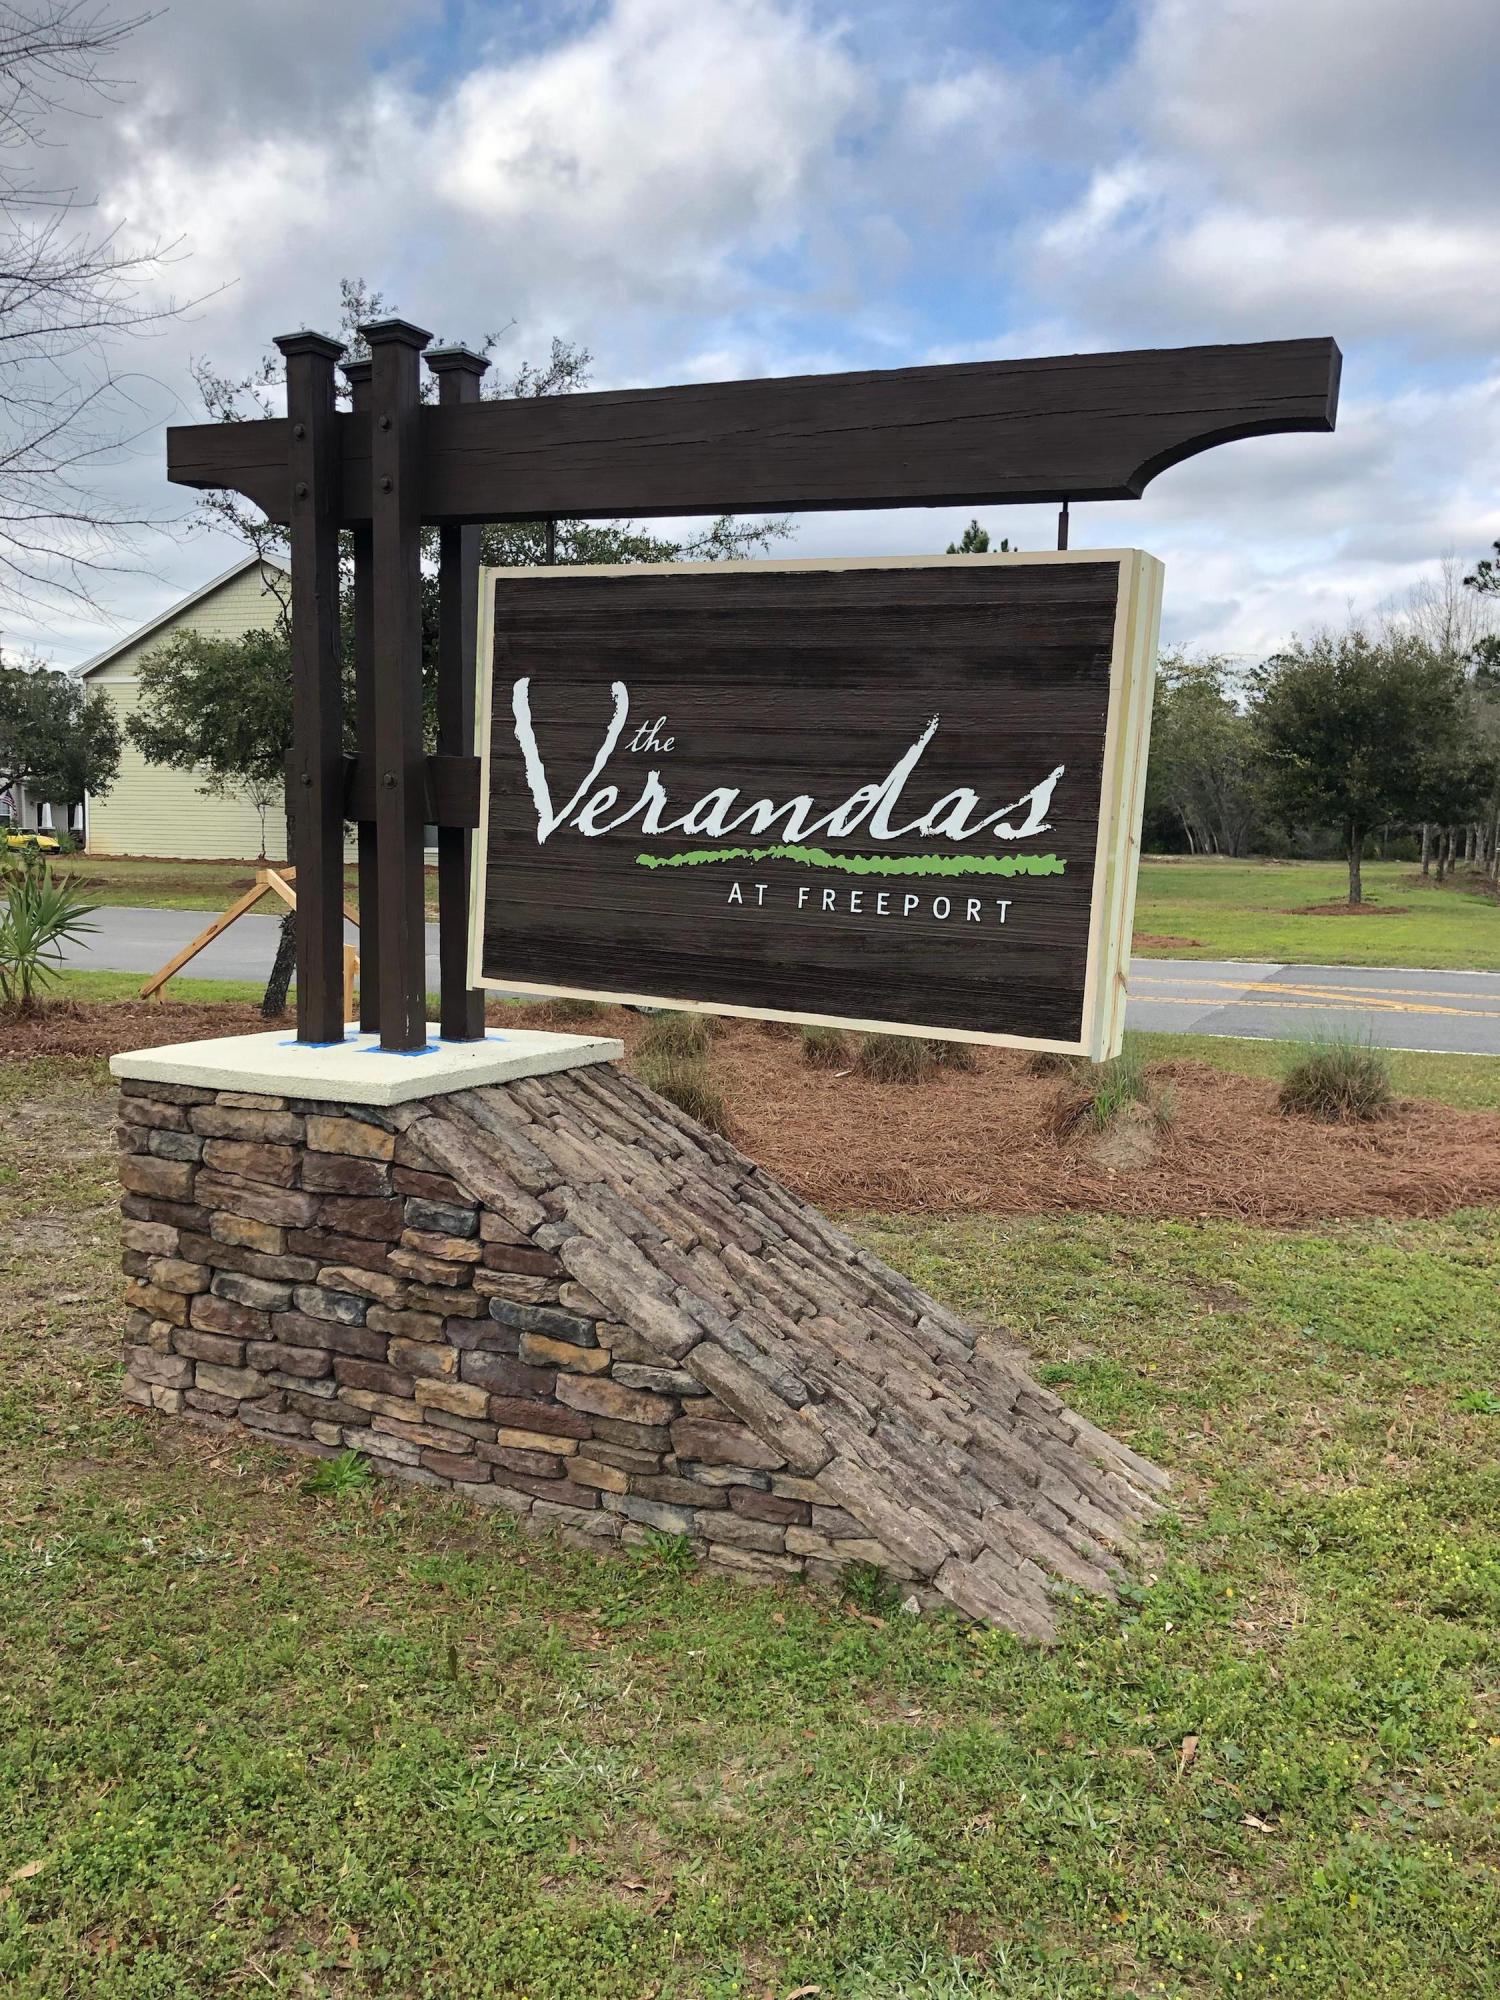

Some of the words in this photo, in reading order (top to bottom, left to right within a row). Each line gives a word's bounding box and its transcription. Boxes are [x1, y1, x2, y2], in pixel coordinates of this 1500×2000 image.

[625, 715, 675, 753] the
[511, 676, 1065, 846] Verandas
[727, 882, 769, 906] AT
[797, 887, 1014, 924] FREEPORT
